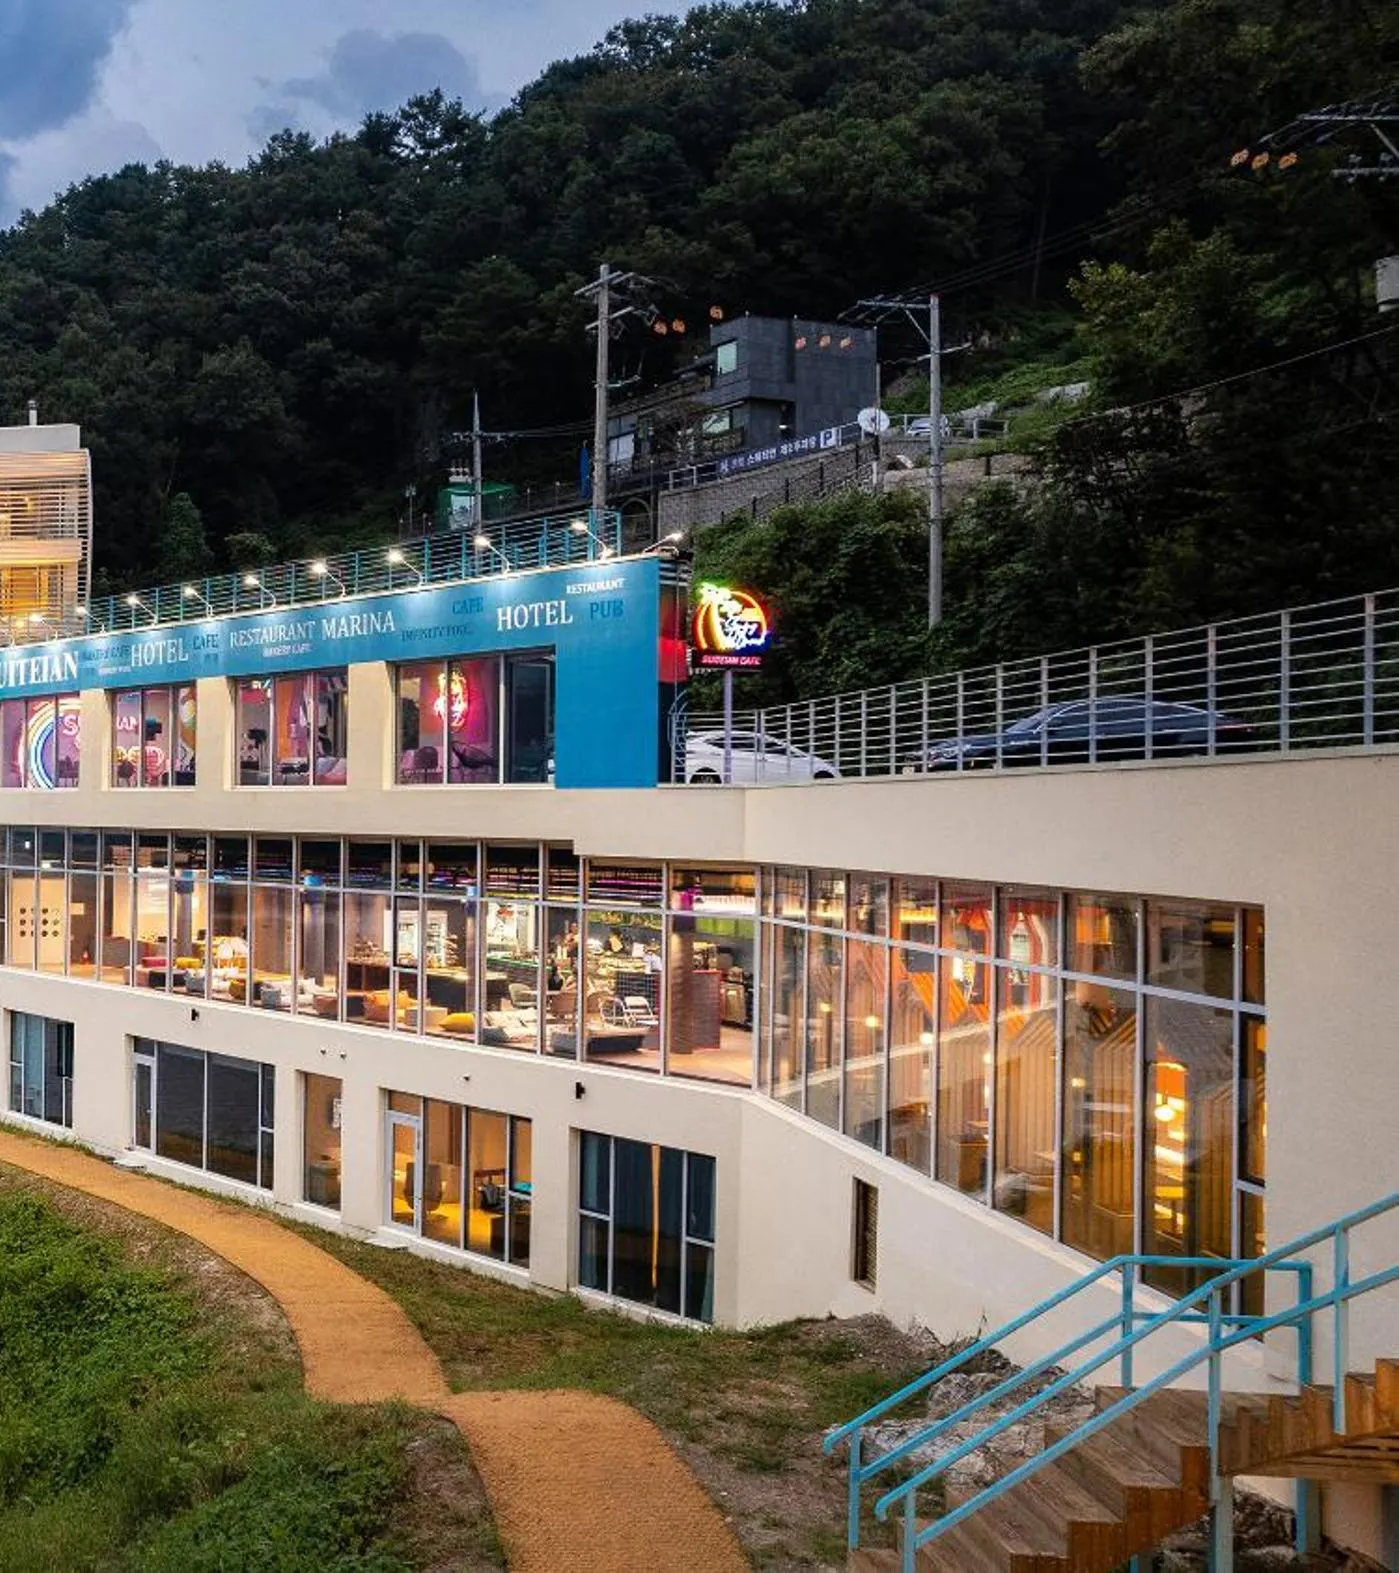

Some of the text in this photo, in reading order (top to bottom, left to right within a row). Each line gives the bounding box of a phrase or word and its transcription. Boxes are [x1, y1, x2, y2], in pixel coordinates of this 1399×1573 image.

[452, 597, 484, 614] CAFE
[497, 600, 573, 631] HOTEL
[589, 600, 624, 620] PUB
[230, 621, 315, 648] RESTAURANT
[321, 610, 396, 640] MARINA
[131, 638, 188, 666] HOTEL
